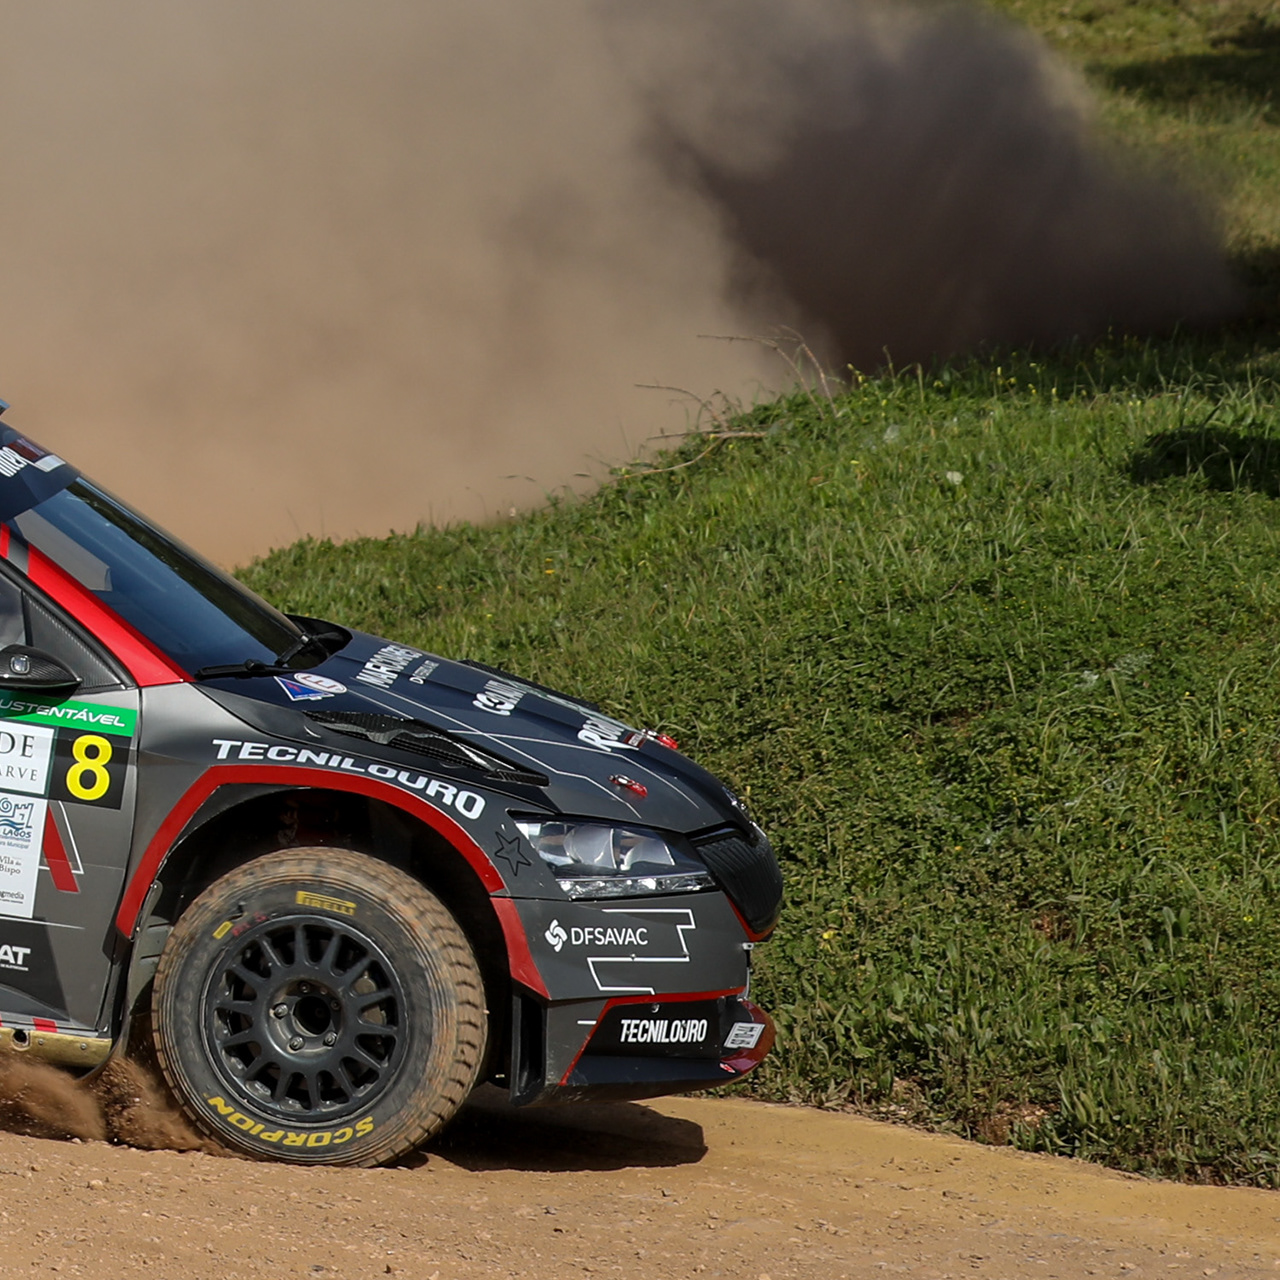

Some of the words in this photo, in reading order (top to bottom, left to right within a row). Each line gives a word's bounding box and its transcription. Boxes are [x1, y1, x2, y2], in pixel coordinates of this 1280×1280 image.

[66, 734, 113, 801] 8
[211, 738, 488, 821] TECNILOURO
[2, 827, 33, 839] LAGOS
[295, 890, 358, 917] PIRELLI
[570, 926, 649, 946] DFSAVAC
[619, 1018, 708, 1044] TECNILOURO
[207, 1095, 375, 1148] SCORPION
